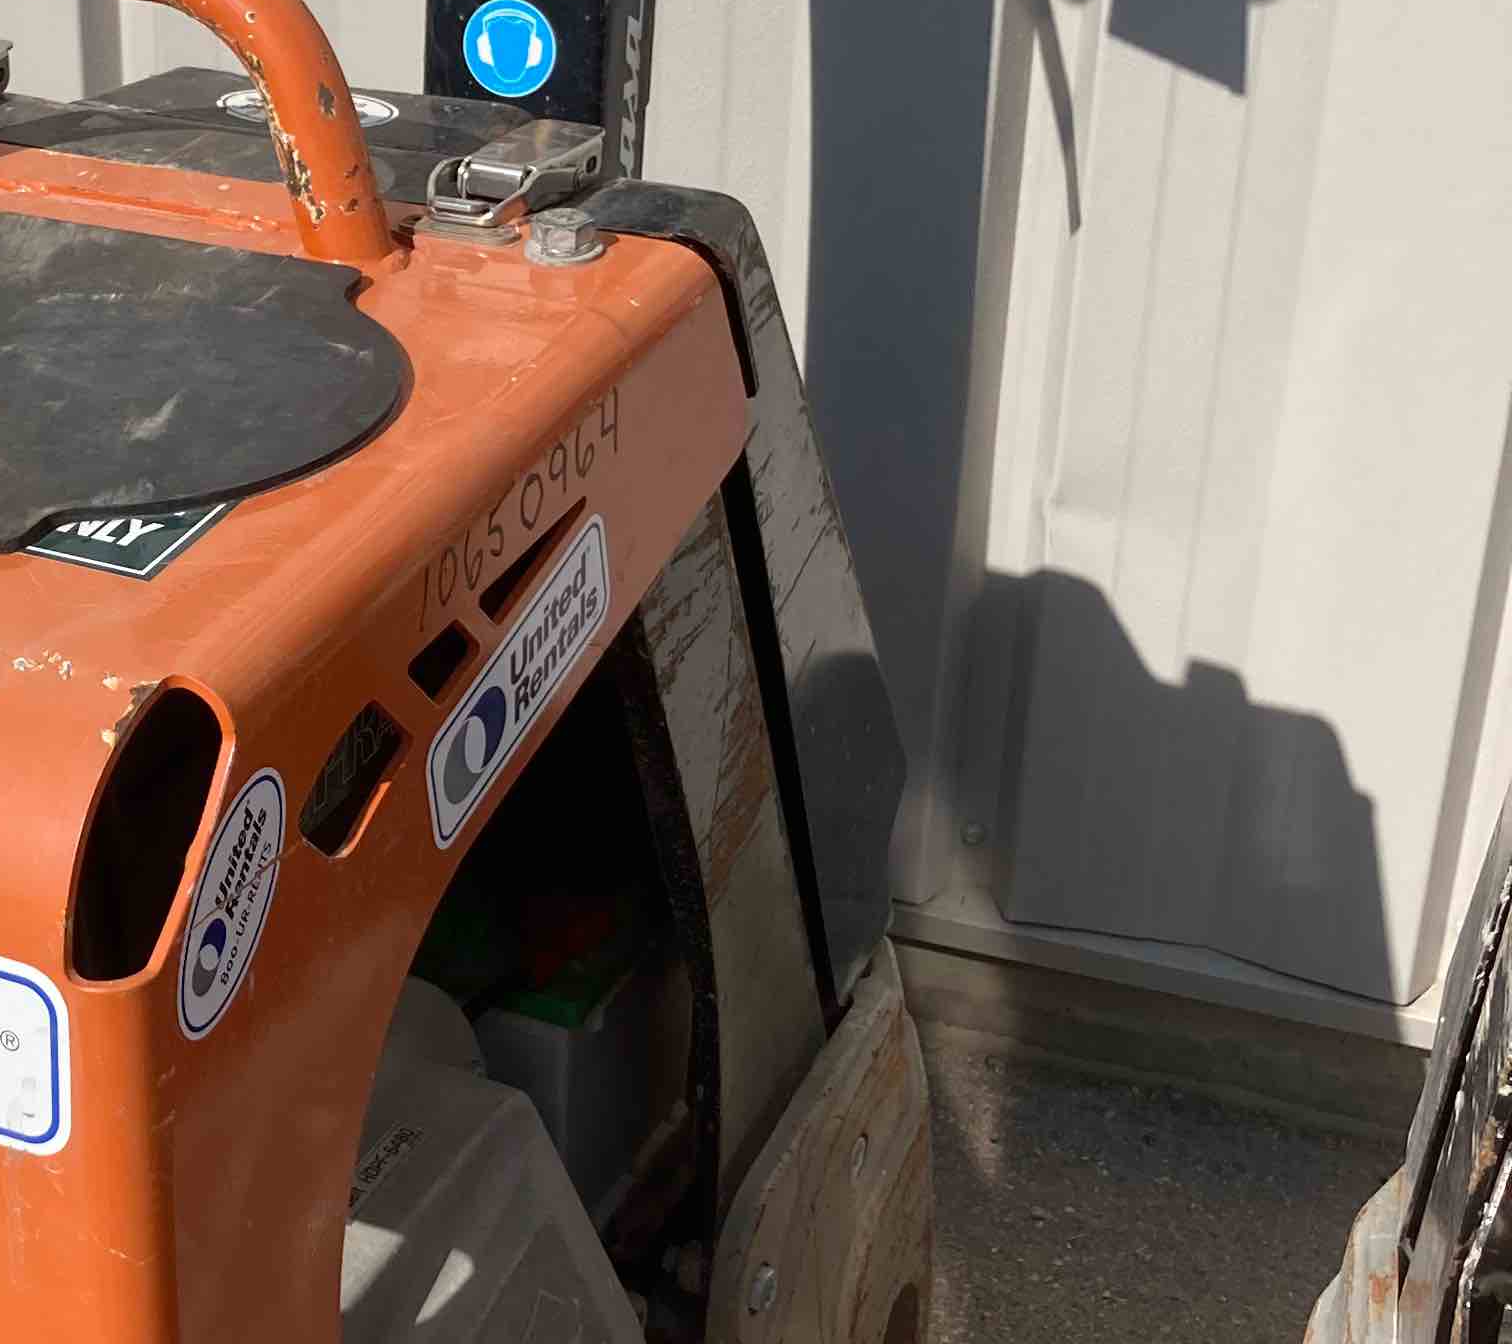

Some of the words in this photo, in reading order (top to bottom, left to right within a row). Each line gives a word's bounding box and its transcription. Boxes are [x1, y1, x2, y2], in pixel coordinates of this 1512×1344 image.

[508, 550, 589, 686] United
[513, 586, 599, 725] Rentals
[214, 806, 256, 910] United
[224, 807, 268, 921] Rentals
